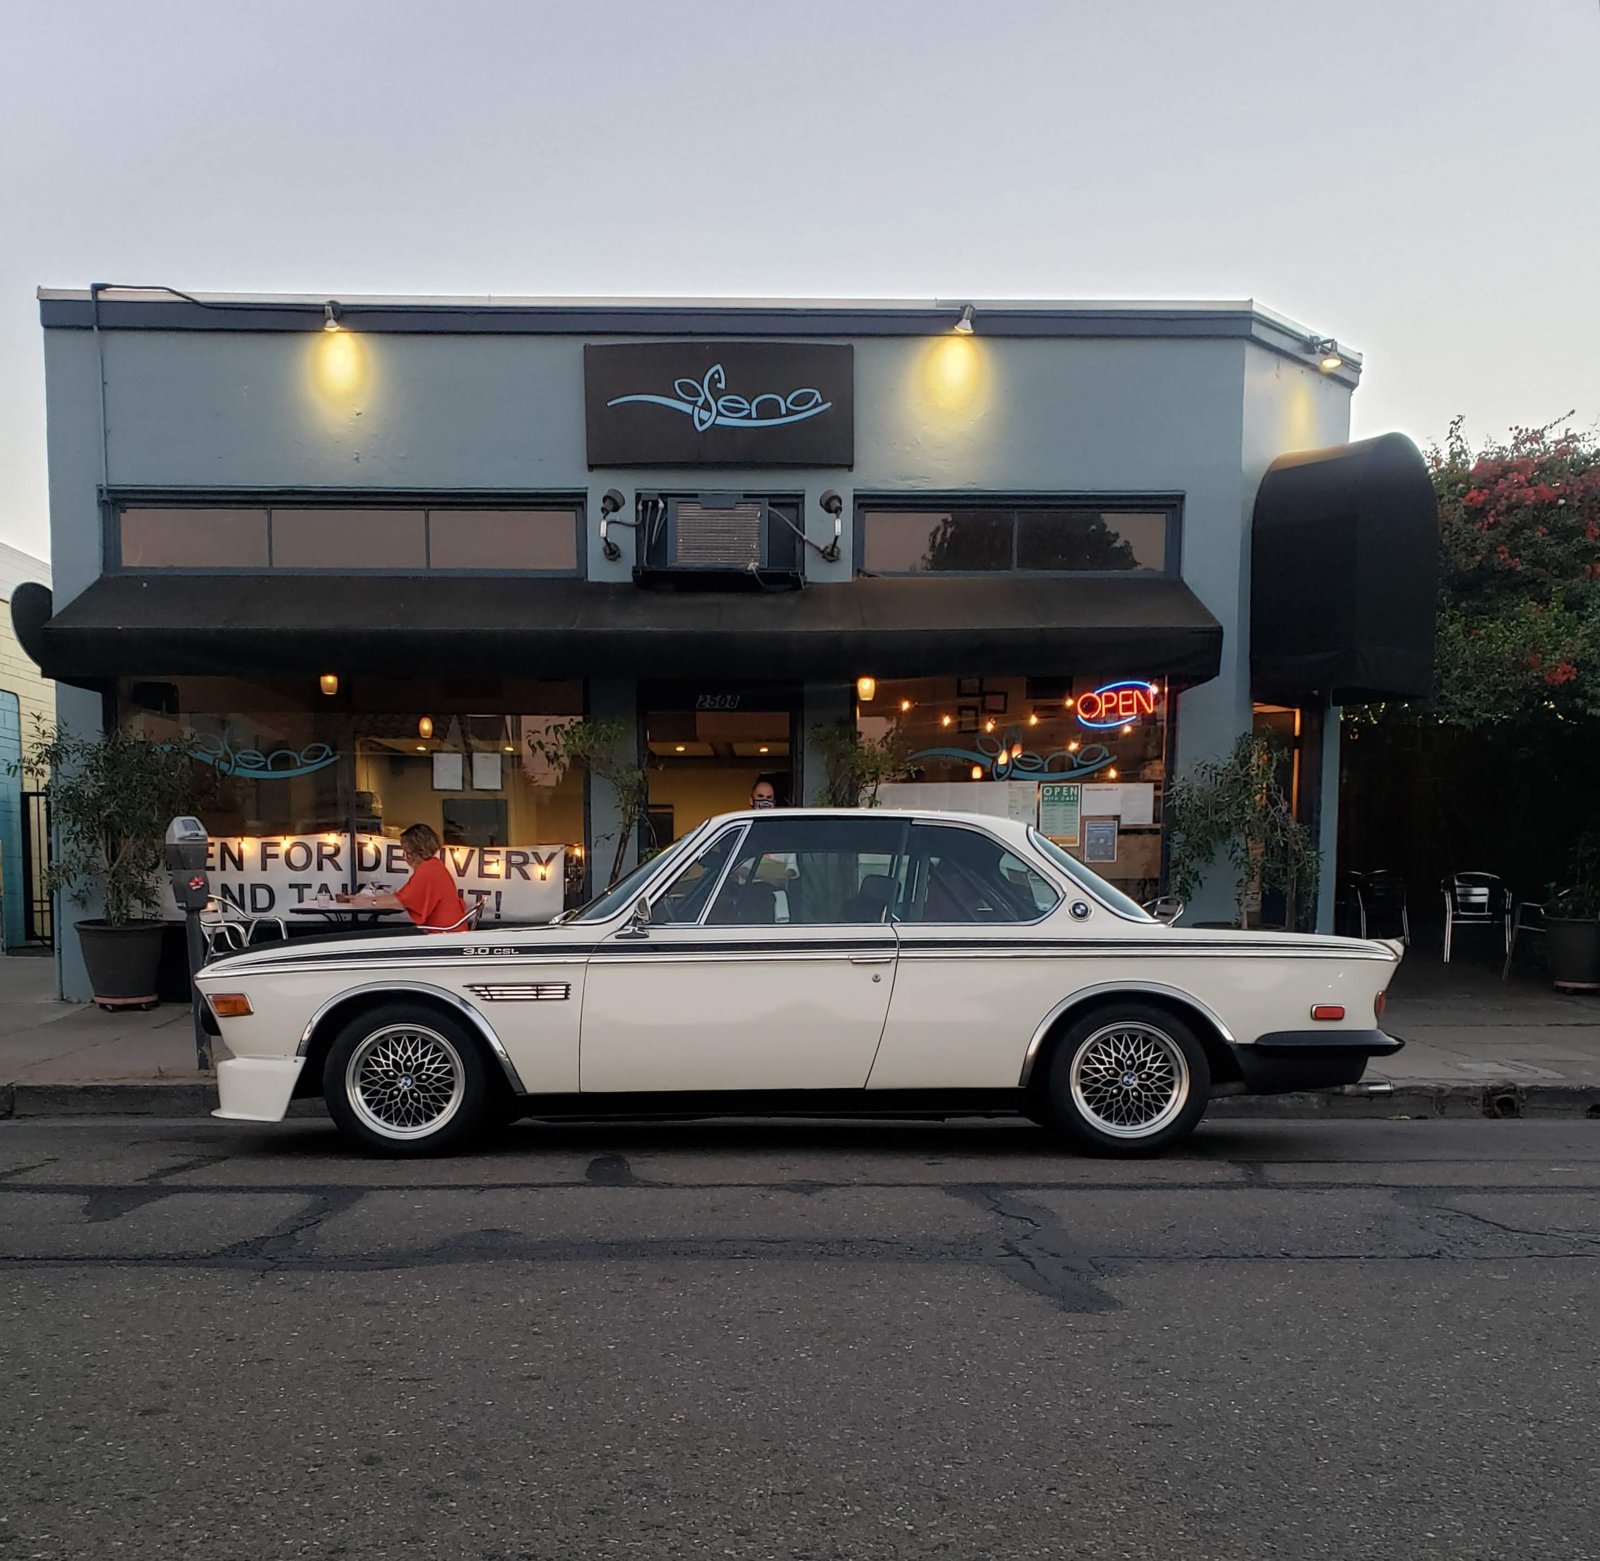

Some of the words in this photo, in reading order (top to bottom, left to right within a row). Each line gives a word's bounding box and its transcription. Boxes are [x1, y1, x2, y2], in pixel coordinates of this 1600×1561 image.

[697, 695, 739, 709] 2508
[1077, 690, 1154, 718] OPEN
[1043, 786, 1078, 796] OPEN
[260, 841, 343, 872] FOR
[357, 841, 558, 881] DEIVERY
[211, 883, 276, 913] ND
[463, 947, 490, 955] 3.0
